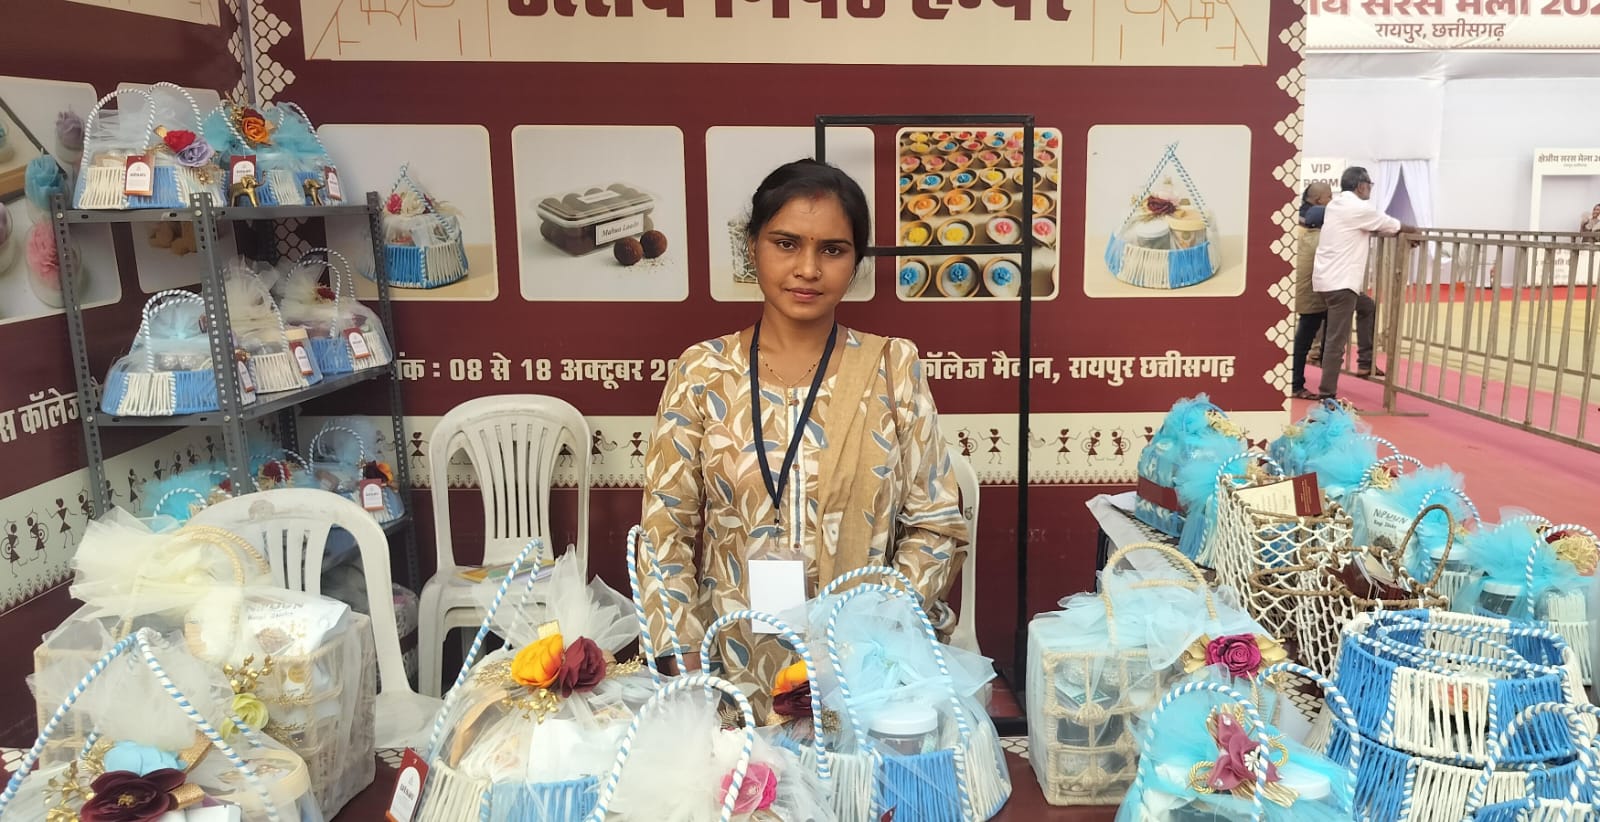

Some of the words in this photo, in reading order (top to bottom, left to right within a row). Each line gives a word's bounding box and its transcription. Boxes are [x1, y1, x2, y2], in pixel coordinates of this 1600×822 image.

[1374, 23, 1427, 43] रायपुर,
[1431, 18, 1506, 42] छत्तीसगढ़
[1311, 163, 1331, 174] VIP
[449, 358, 483, 381] 08
[489, 351, 511, 381] से
[520, 358, 552, 381] 18
[560, 358, 644, 390] अक्टूबर
[1068, 356, 1136, 387] रायपुर
[1139, 350, 1236, 383] छत्तीसगढ़
